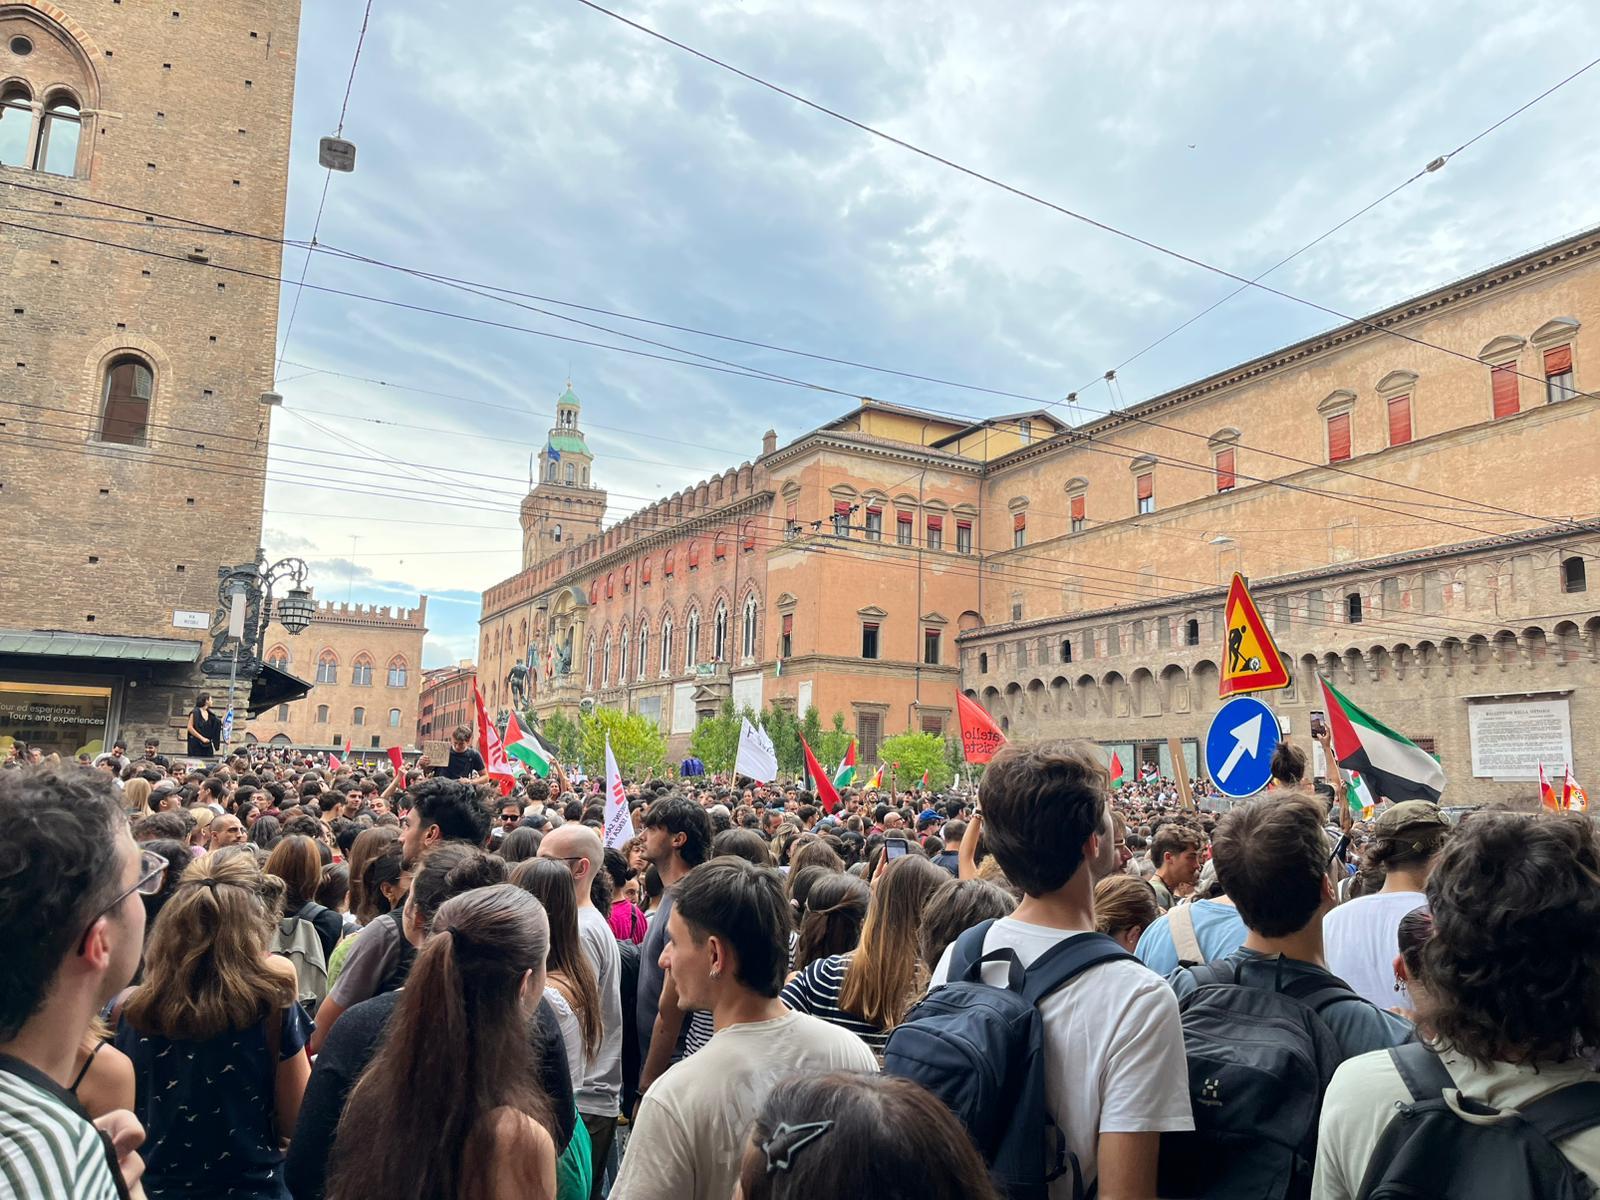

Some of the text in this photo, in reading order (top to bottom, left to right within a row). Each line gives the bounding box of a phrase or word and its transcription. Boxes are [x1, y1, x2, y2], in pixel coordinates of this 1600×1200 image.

[17, 703, 28, 711] ed
[30, 704, 77, 715] esperienze
[8, 711, 105, 725] Tours and experiences
